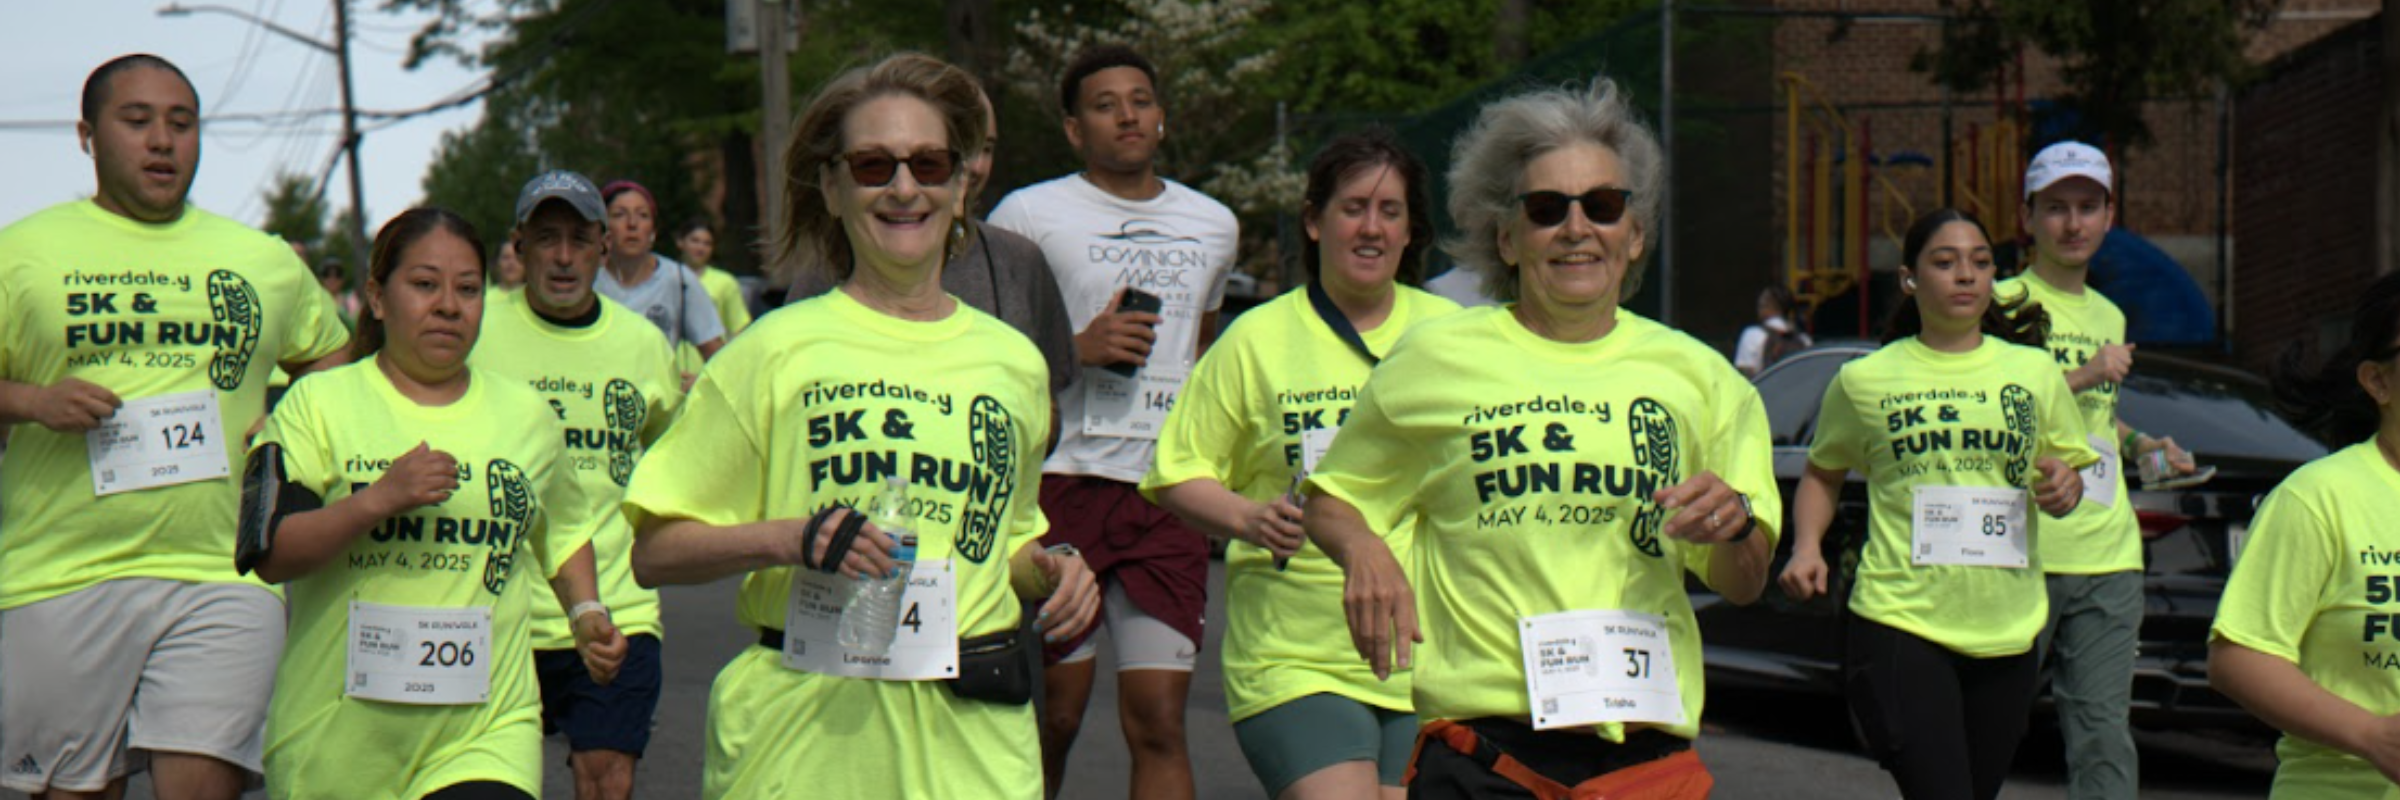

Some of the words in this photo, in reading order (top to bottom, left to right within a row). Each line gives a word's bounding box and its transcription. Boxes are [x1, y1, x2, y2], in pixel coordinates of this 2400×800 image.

[1089, 245, 1207, 269] DOMINICAN
[64, 269, 192, 293] riverdale.y
[1115, 267, 1189, 288] MAGIC
[66, 292, 119, 316] 5K
[131, 292, 159, 314] &
[66, 321, 144, 348] FUN
[158, 321, 238, 348] RUN
[67, 351, 113, 368] MAY
[119, 351, 138, 366] 4,
[145, 352, 196, 368] 2025
[529, 376, 593, 399] dale.y
[803, 378, 953, 416] riverdale.y
[1277, 385, 1358, 405] riverdal
[1881, 388, 1987, 409] riverdale.y
[1145, 391, 1174, 412] 146
[1463, 395, 1611, 425] riverdale.y
[808, 409, 868, 448] 5K
[881, 408, 916, 440] &
[1283, 408, 1325, 435] 5K
[1888, 405, 1926, 432] 5K
[1938, 404, 1960, 422] &
[162, 421, 205, 450] 124
[565, 428, 625, 450] RUN
[1471, 423, 1530, 462] 5K
[1542, 421, 1577, 452] &
[1891, 429, 1952, 461] FUN
[1962, 428, 2023, 455] RUN
[810, 450, 897, 493] FUN
[911, 451, 992, 505] RUN
[1953, 458, 1993, 472] 2025
[1474, 462, 1560, 503] FUN
[1572, 462, 1658, 501] RUN
[898, 497, 953, 524] 2025
[1477, 505, 1527, 530] MAY
[1534, 505, 1552, 526] 4,
[1559, 504, 1617, 525] 2025
[370, 516, 425, 543] UN
[435, 517, 513, 547] RUN
[1983, 514, 2006, 536] 85
[349, 552, 390, 569] MAY
[395, 552, 413, 570] 4,
[420, 552, 471, 571] 2025
[419, 641, 474, 667] 206
[1623, 647, 1650, 678] 37
[2362, 651, 2400, 670] MA
